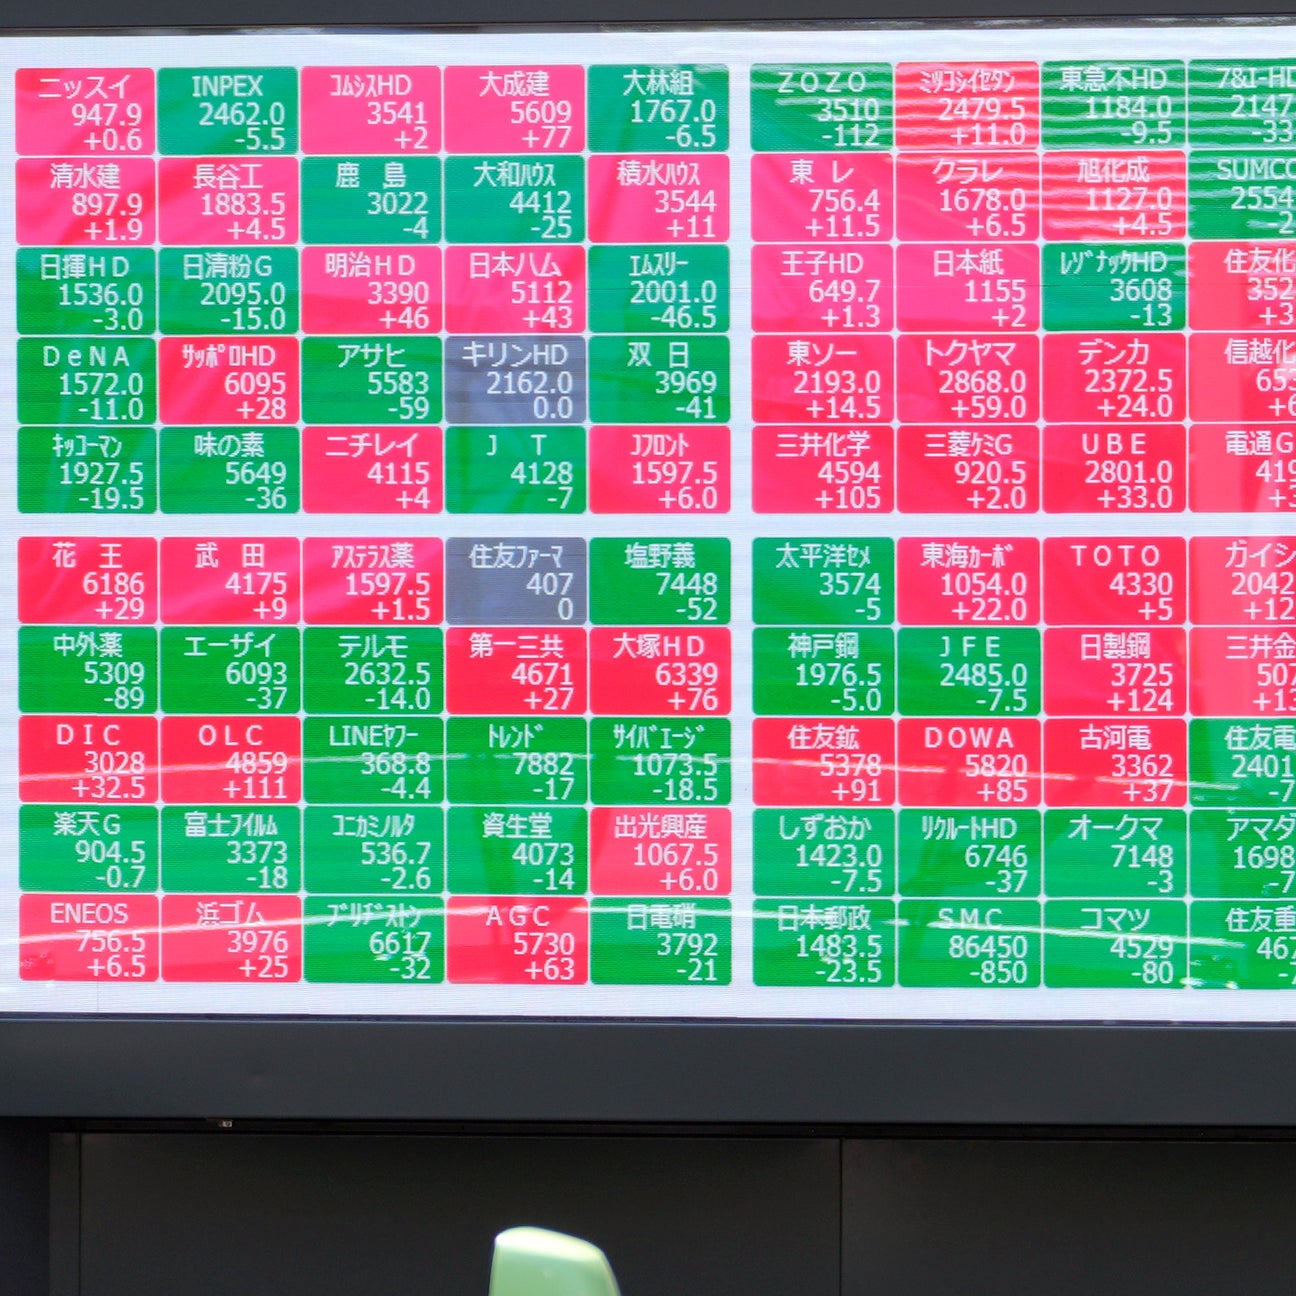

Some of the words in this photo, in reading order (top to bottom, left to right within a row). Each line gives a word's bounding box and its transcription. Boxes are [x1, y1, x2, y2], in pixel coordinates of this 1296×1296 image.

[37, 73, 131, 100] ニッスイ
[191, 73, 264, 99] INPEX
[478, 68, 550, 98] 大成建
[71, 102, 143, 127] 947.9
[198, 100, 286, 127] 2462.0
[510, 99, 573, 125] 5609
[83, 127, 143, 152] +0.6
[234, 125, 287, 152] -5.5
[521, 124, 573, 149] +77
[469, 250, 563, 279] 日本ハム
[780, 249, 865, 277] 王子HD
[511, 279, 574, 305] 5112
[808, 278, 882, 303] 649.7
[522, 304, 573, 330] +43
[821, 303, 881, 329] +1.3
[337, 342, 406, 369] アサヒ
[461, 340, 569, 368] キリンHD
[925, 338, 1017, 367] トクヤマ
[367, 370, 430, 396] 5583
[486, 370, 574, 395] 2162.0
[938, 369, 1027, 394] 2868.0
[387, 394, 430, 420] -59
[532, 395, 574, 420] 0.0
[950, 394, 1027, 418] +59.0
[195, 430, 265, 458] 味の素
[775, 430, 871, 458] 三井化学
[225, 460, 288, 486] 5649
[817, 460, 882, 485] 4594
[244, 485, 288, 510] -36
[814, 485, 882, 509] +105
[624, 540, 696, 569] 塩野義
[655, 571, 718, 597] 7448
[675, 595, 718, 622] -52
[53, 631, 123, 658] 中外薬
[337, 633, 409, 659] テルモ
[468, 632, 564, 660] 第一三共
[787, 632, 859, 660] 神戸鋼
[1080, 631, 1151, 661] 日製鋼
[83, 660, 146, 686] 5309
[344, 661, 431, 686] 2632.5
[510, 661, 574, 687] 4671
[795, 661, 882, 688] 1976.5
[1110, 662, 1174, 688] 3725
[103, 684, 145, 711] -89
[365, 686, 431, 712] -14.0
[523, 686, 575, 712] +27
[830, 686, 882, 713] -5.0
[1106, 687, 1175, 713] +124
[614, 812, 708, 840] 出光興産
[1067, 813, 1164, 842] オークマ
[633, 841, 719, 867] 1067.5
[1110, 843, 1174, 870] 7148
[659, 867, 719, 891] +6.0
[1146, 868, 1174, 894] -3
